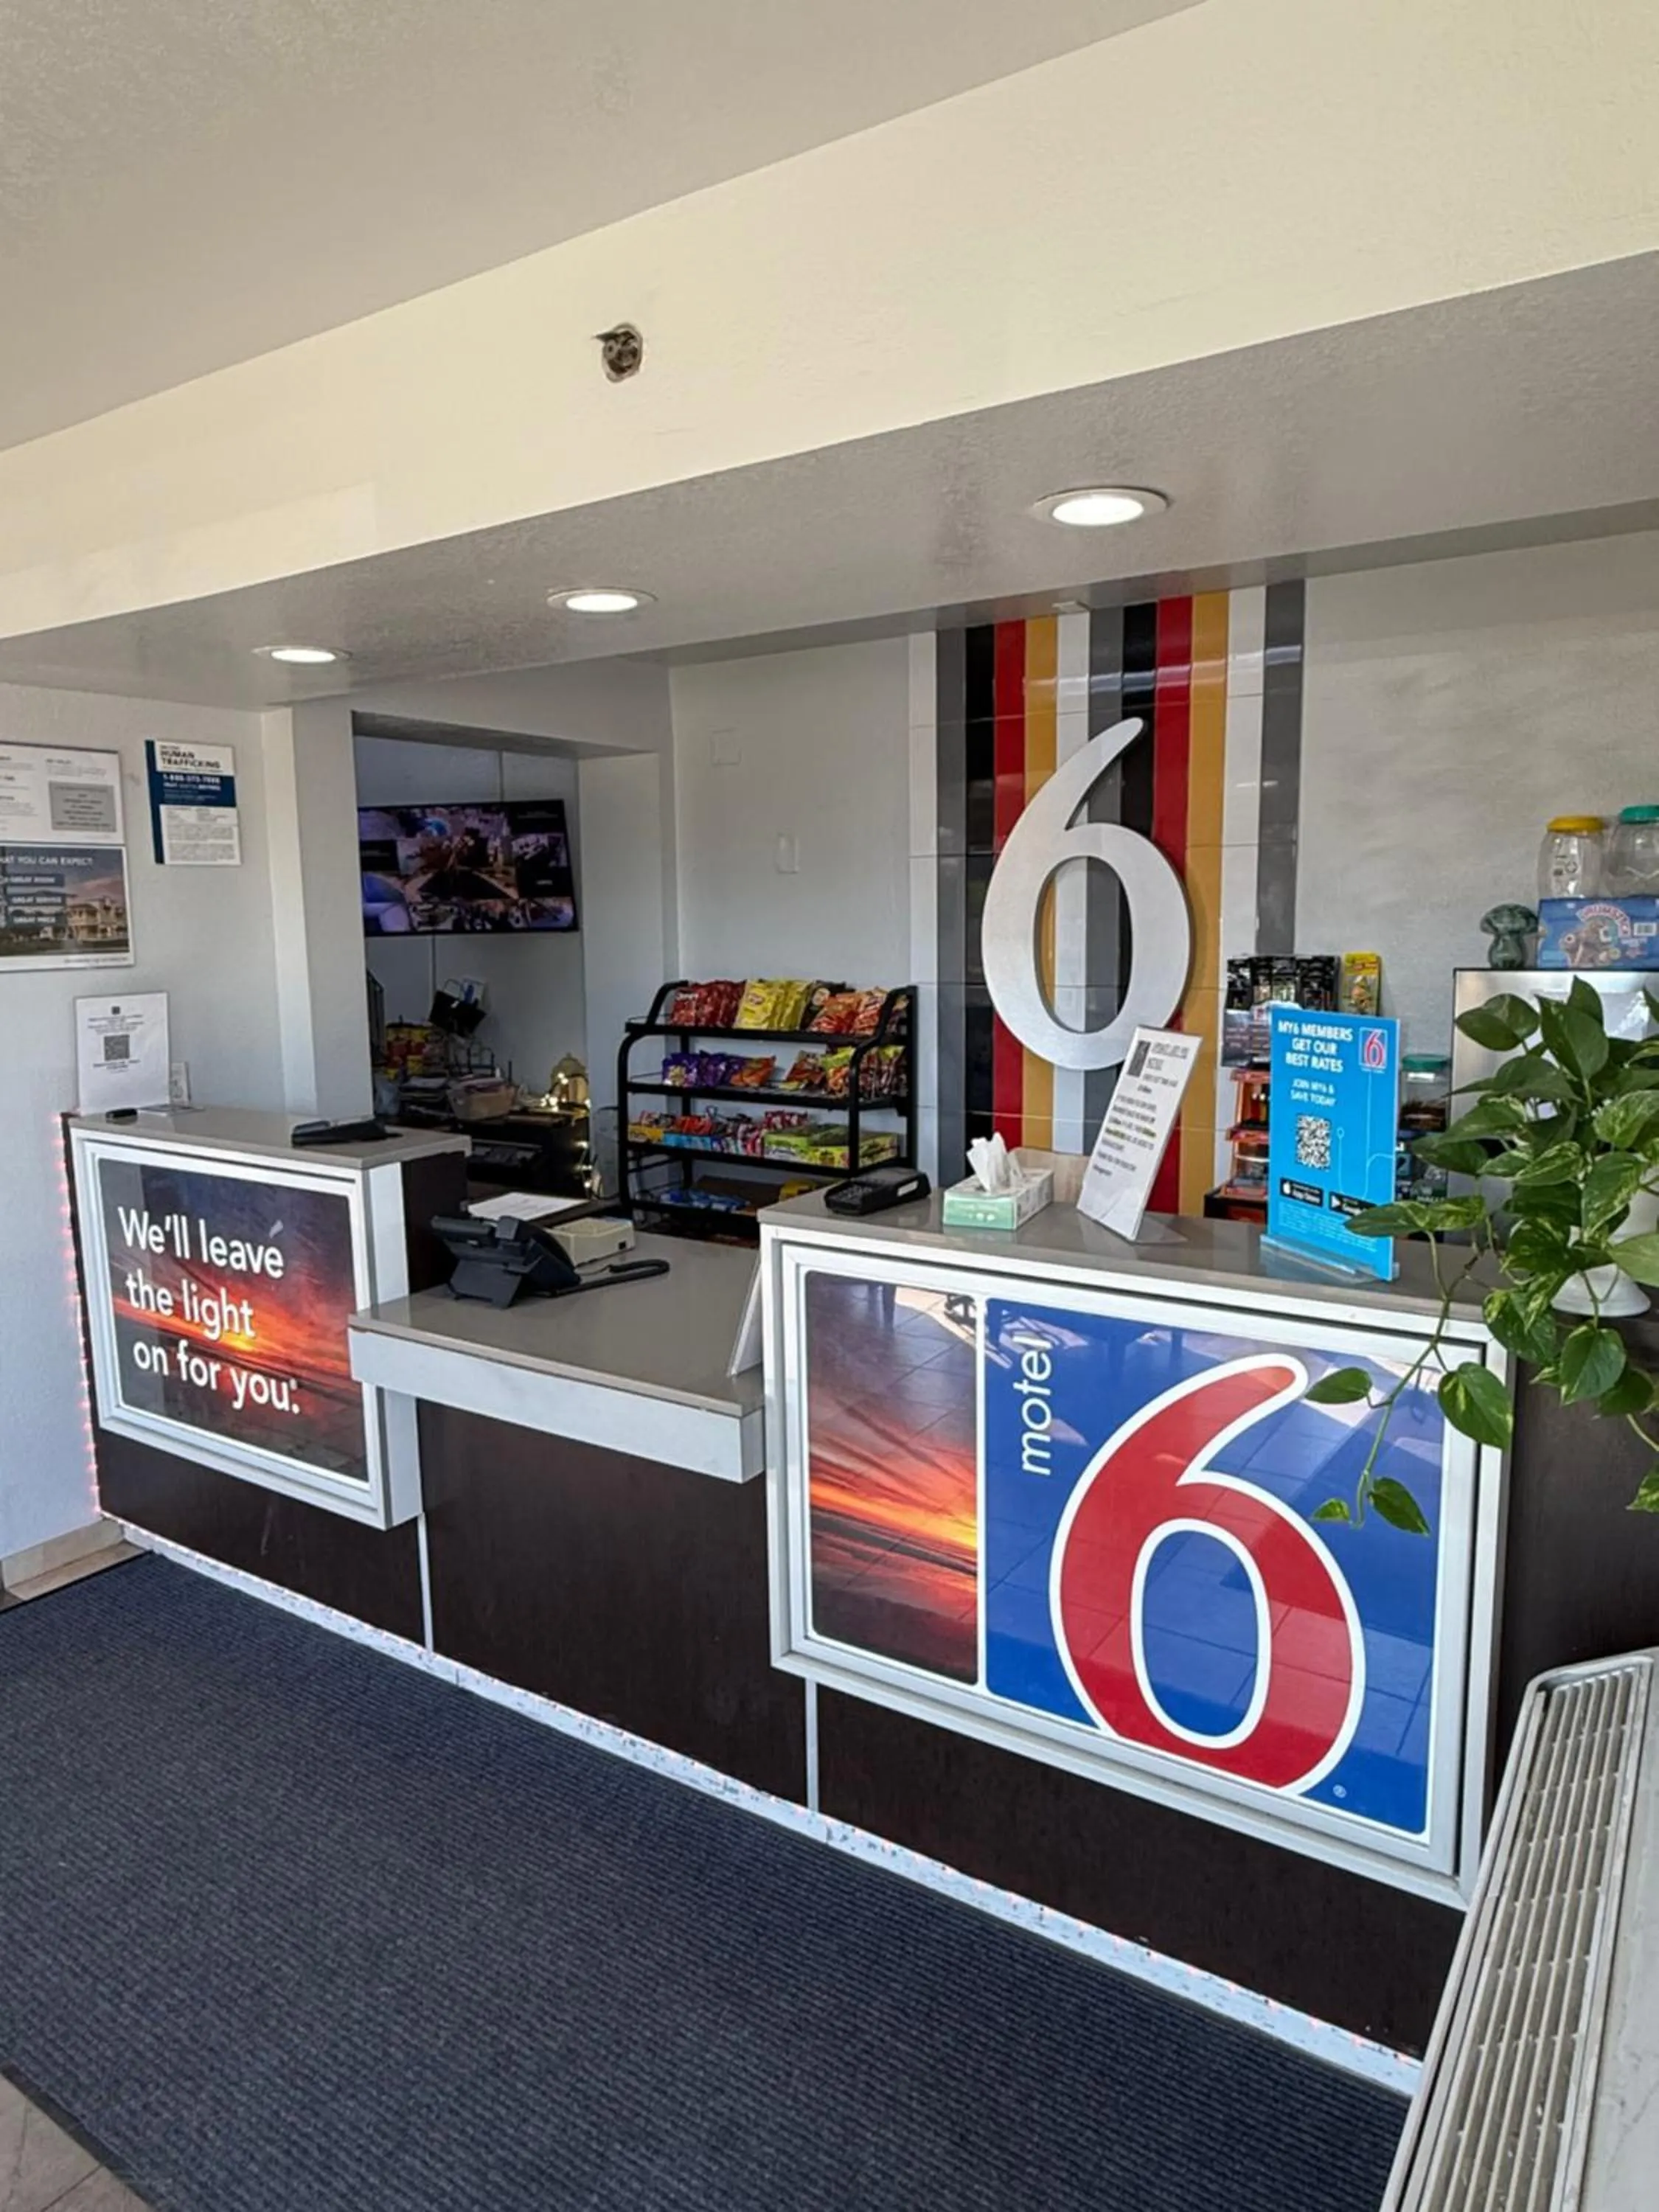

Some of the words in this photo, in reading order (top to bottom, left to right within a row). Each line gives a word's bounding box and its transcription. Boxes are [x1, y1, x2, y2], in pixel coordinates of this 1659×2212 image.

[161, 757, 220, 768] TRAFFICKING
[981, 717, 1190, 1071] 6
[1291, 1037, 1312, 1051] GET
[1312, 1040, 1338, 1055] OUR
[1301, 1023, 1354, 1042] MEMBERS
[1285, 1052, 1310, 1068] BEST
[1310, 1056, 1344, 1073] RATES
[1310, 1093, 1337, 1107] TODAY
[117, 1206, 191, 1260] We'll
[198, 1217, 285, 1279] leave
[125, 1267, 174, 1317] the
[181, 1278, 256, 1341] light
[133, 1341, 170, 1377] on
[176, 1339, 221, 1391] for
[1012, 1335, 1054, 1476] motel
[1049, 1352, 1366, 1798] 6
